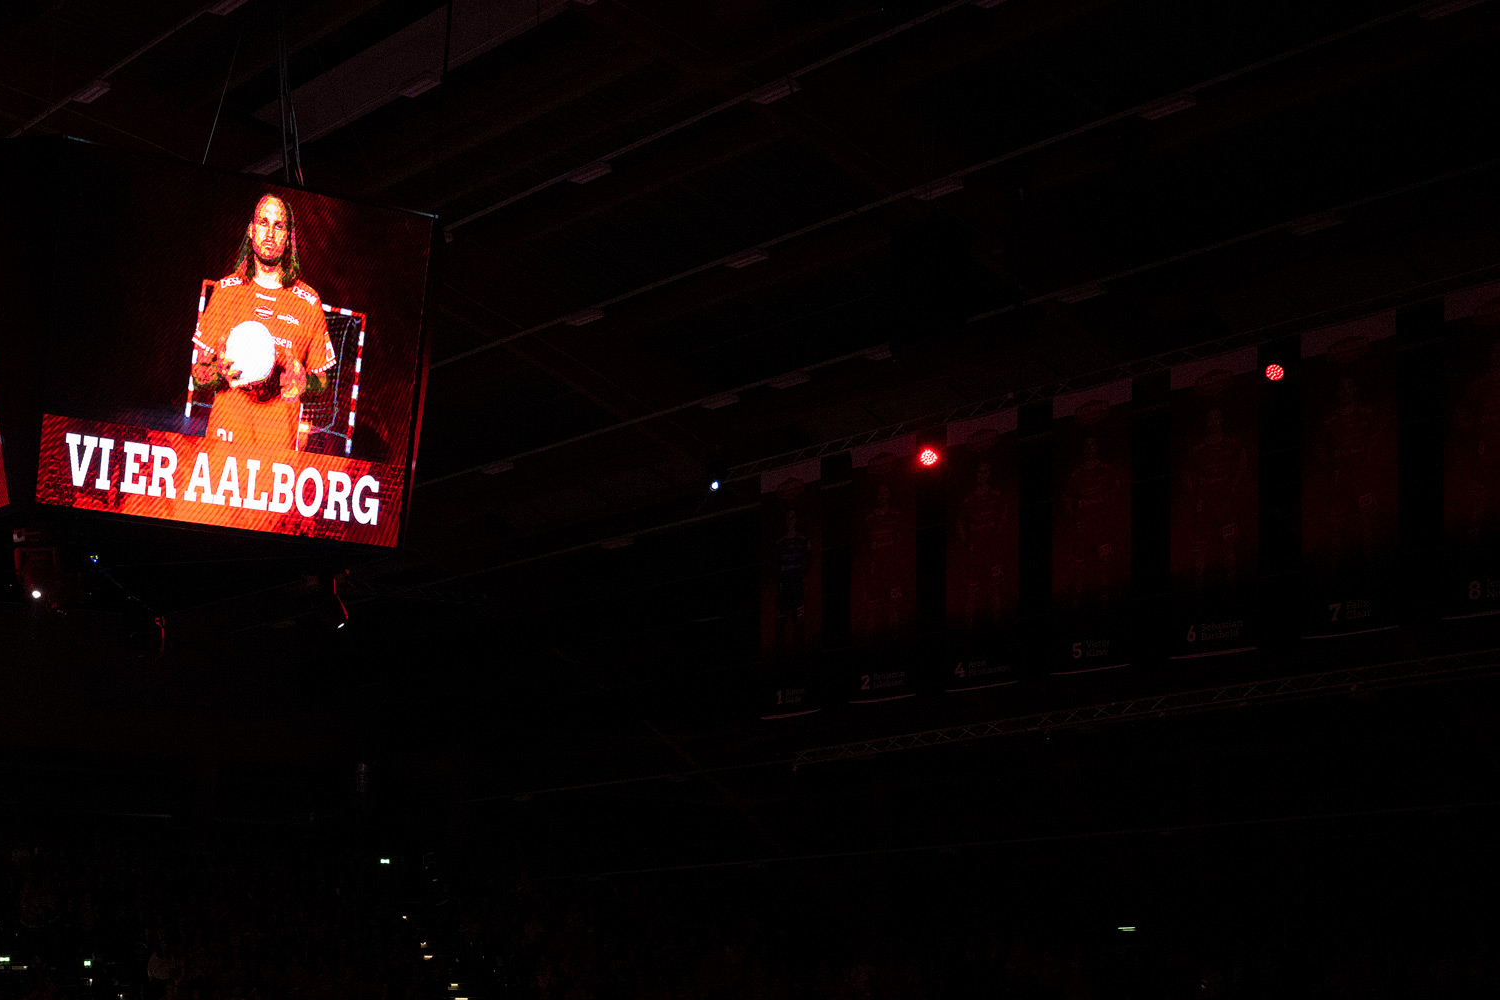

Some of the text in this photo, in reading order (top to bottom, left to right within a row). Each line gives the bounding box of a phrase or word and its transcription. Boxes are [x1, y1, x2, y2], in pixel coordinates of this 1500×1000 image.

[65, 432, 381, 526] VI ER AALBORG
[1468, 580, 1481, 600] 8
[1328, 603, 1342, 622] 7
[1187, 625, 1196, 643] 6
[1072, 642, 1083, 659] 5
[954, 662, 966, 678] 4
[860, 674, 871, 690] 2
[776, 690, 783, 705] 1
